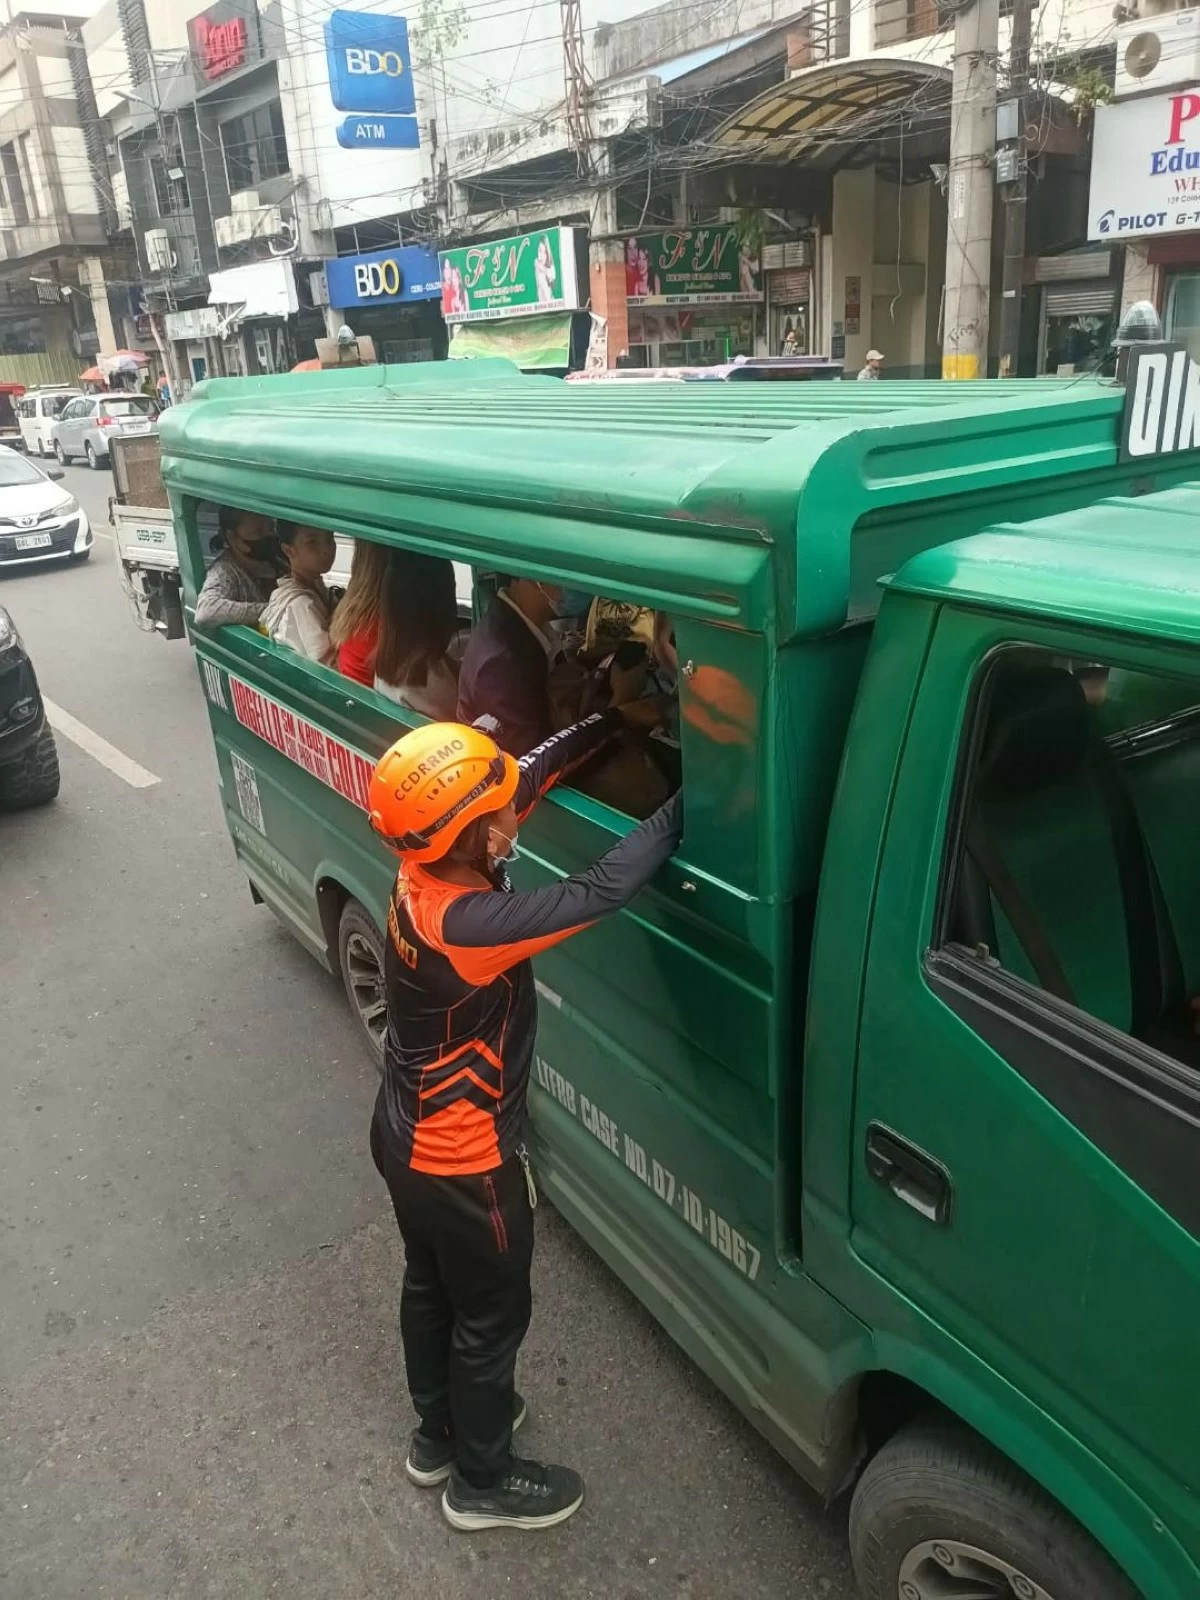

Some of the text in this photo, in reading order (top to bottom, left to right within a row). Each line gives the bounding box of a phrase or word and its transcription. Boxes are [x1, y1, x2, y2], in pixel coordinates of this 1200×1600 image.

[346, 49, 403, 77] BDO
[356, 124, 385, 139] ATM
[1118, 212, 1167, 231] PILOT
[354, 259, 399, 297] BDO
[394, 738, 465, 801] CCDRRMO
[536, 1055, 577, 1116] LTFRB
[580, 1093, 620, 1156] CASE
